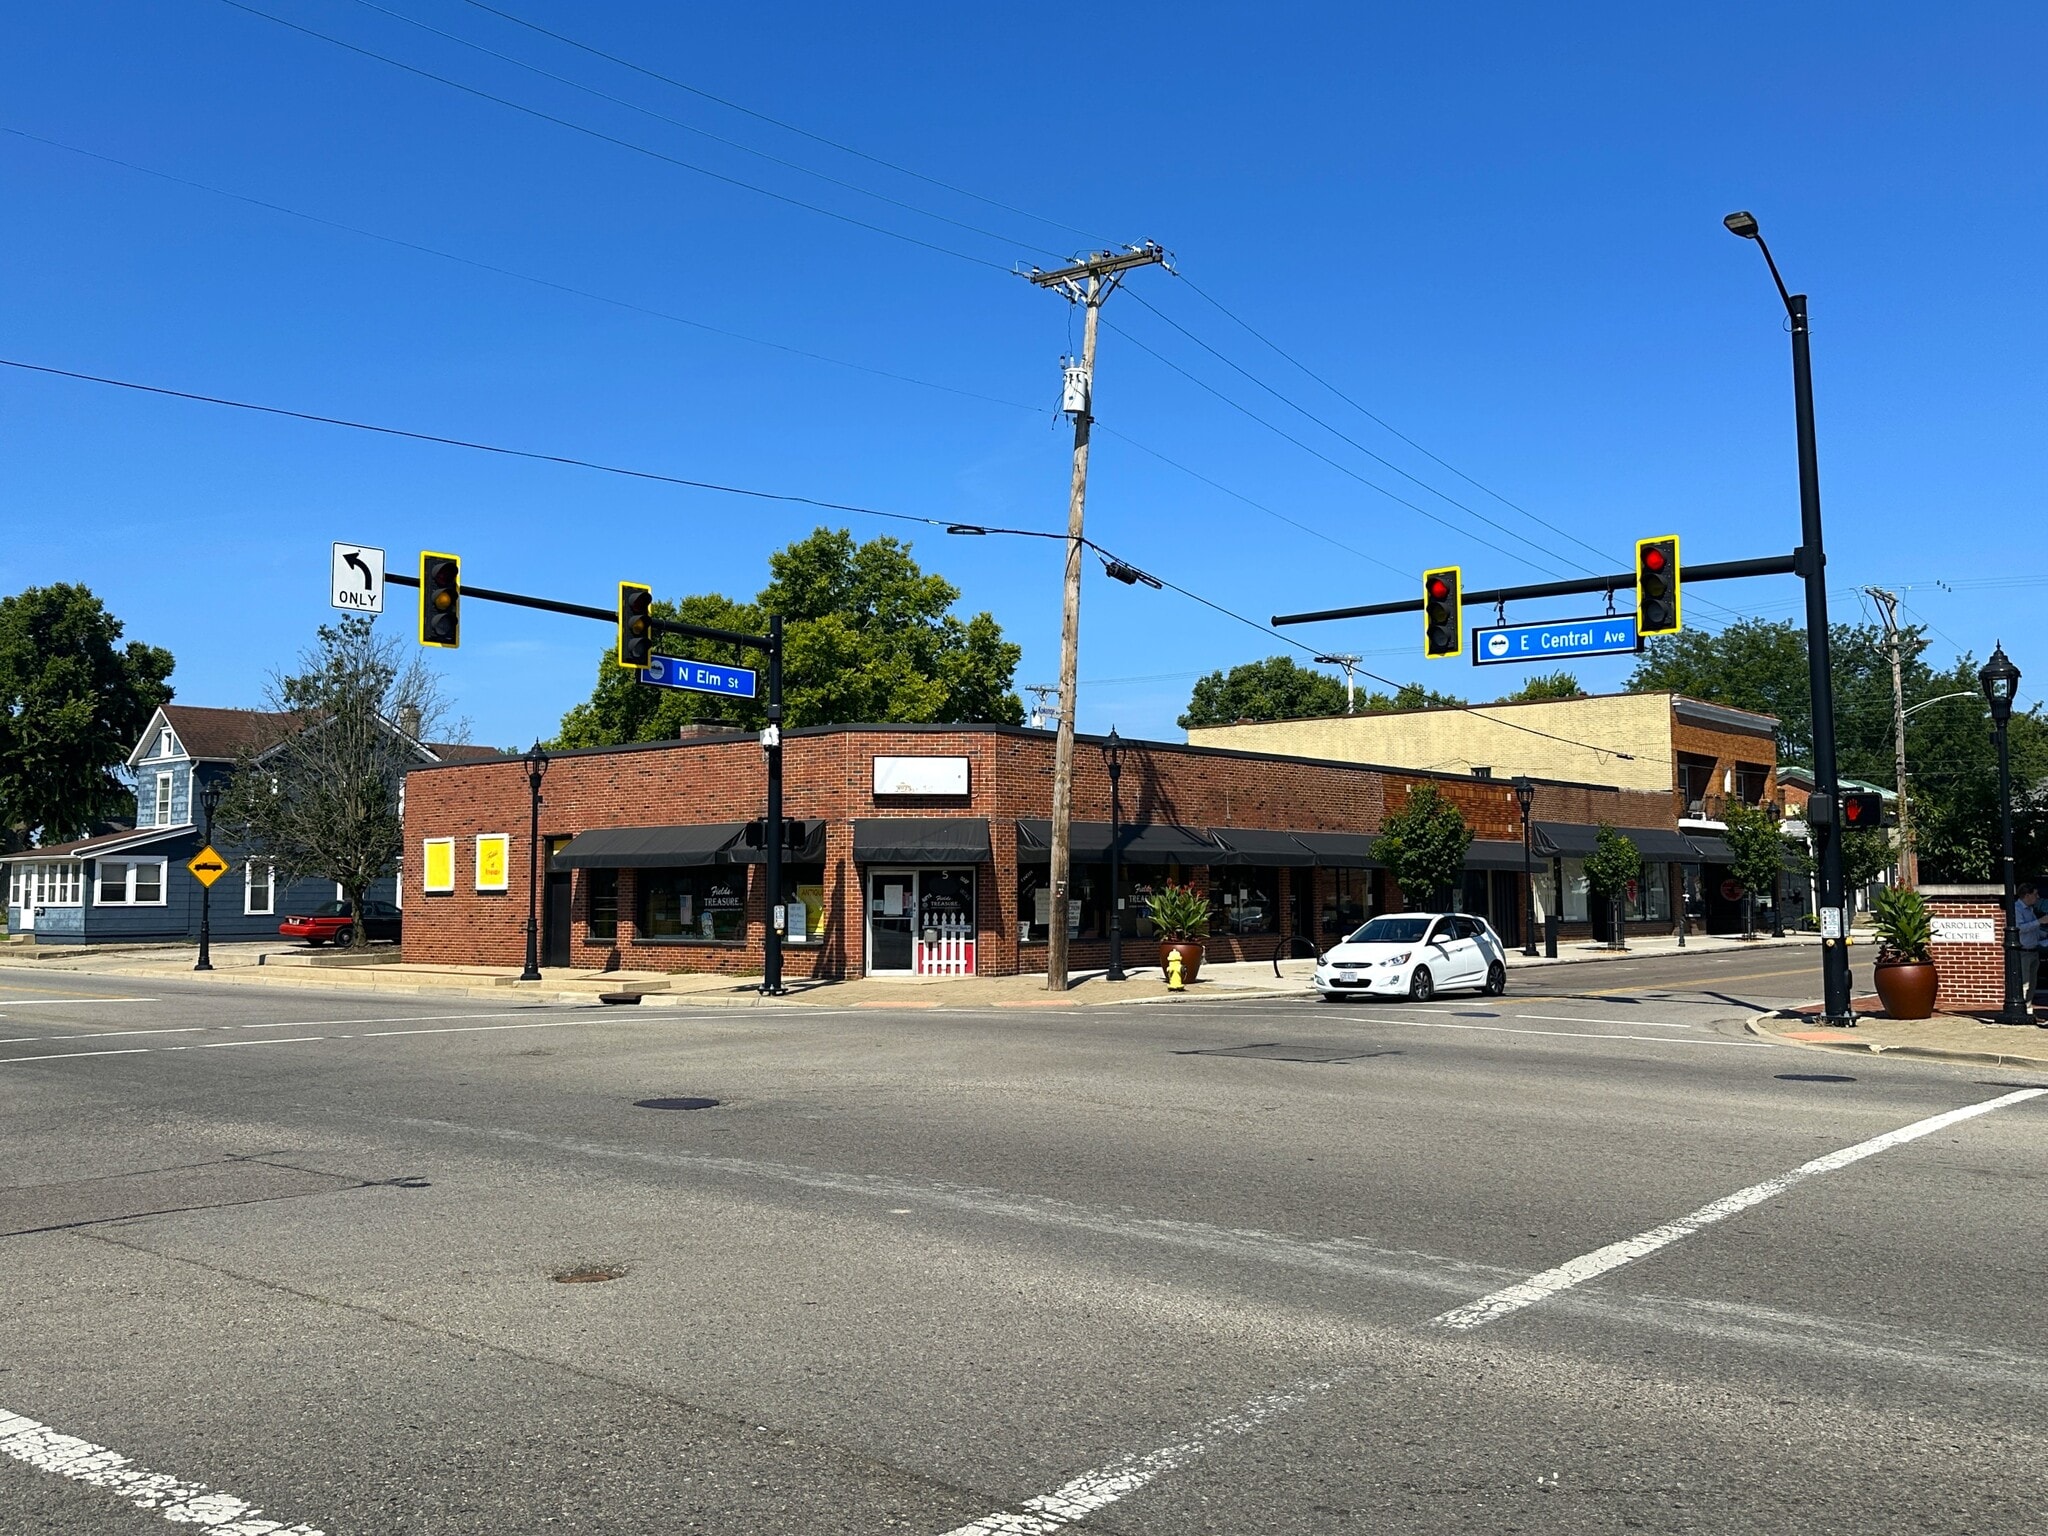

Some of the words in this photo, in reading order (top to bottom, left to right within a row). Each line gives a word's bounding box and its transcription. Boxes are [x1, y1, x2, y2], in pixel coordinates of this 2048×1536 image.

[339, 590, 377, 606] ONLY
[1520, 635, 1529, 651] E
[1541, 629, 1593, 649] Central
[1604, 631, 1626, 643] Ave
[678, 666, 689, 681] N
[696, 669, 721, 686] Elm
[727, 677, 739, 689] St
[703, 897, 740, 907] TREASURE
[1931, 921, 1992, 929] CARROLLTON
[1944, 932, 1980, 940] CENTRE
